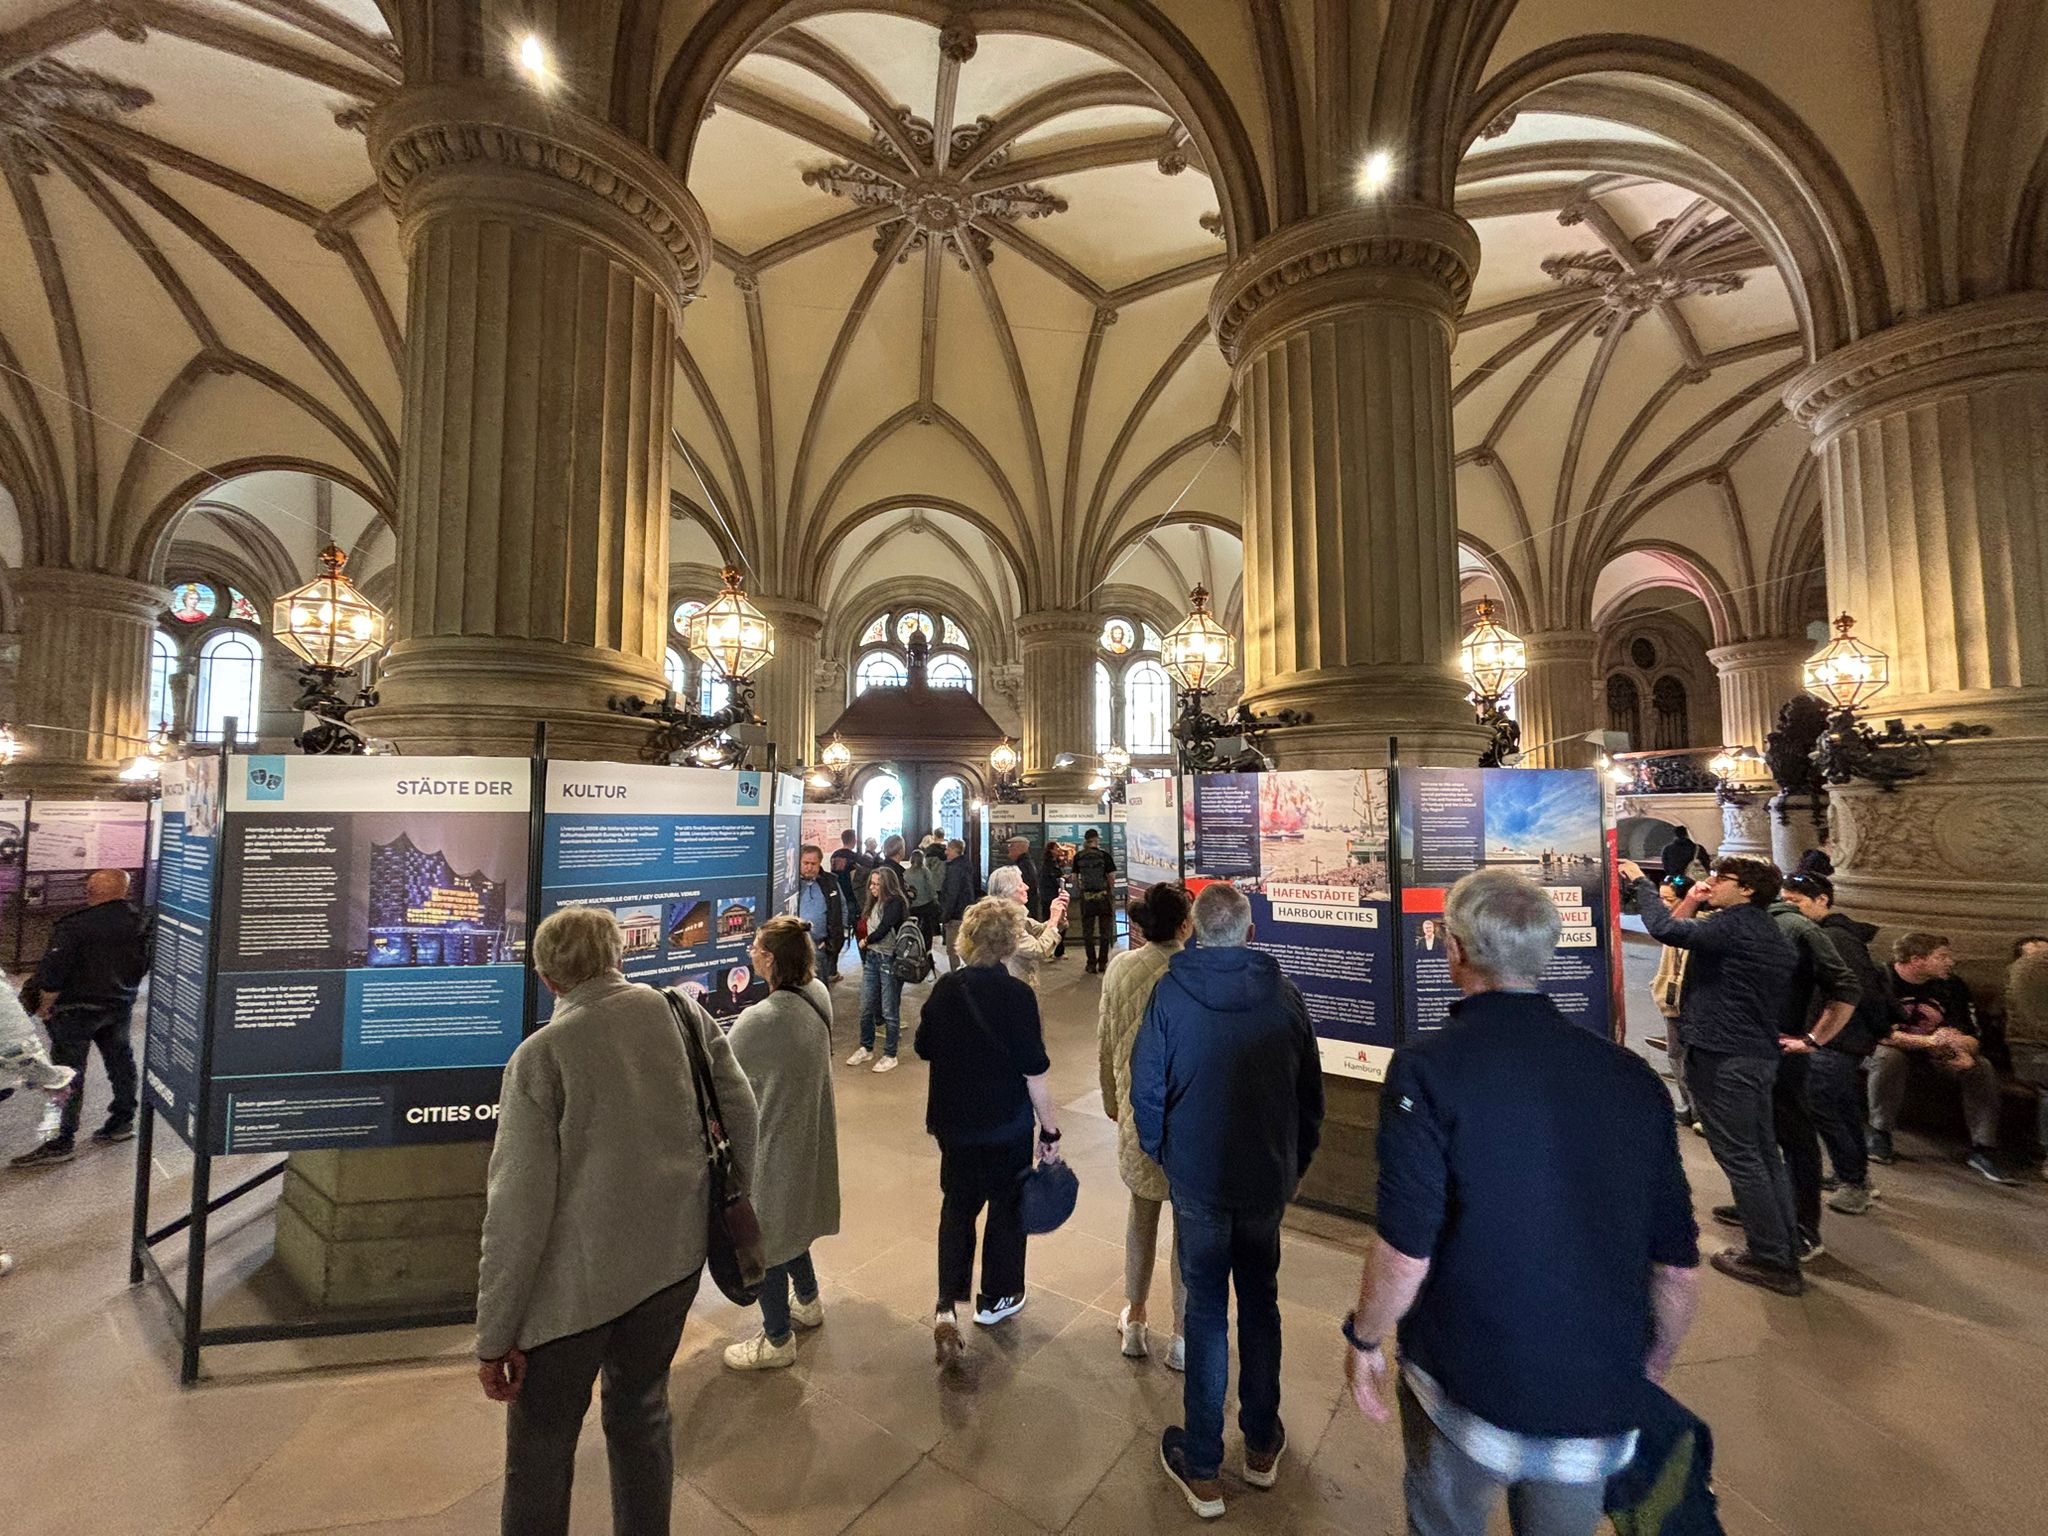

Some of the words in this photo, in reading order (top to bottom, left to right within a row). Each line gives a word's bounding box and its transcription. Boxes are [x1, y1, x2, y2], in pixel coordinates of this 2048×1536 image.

[397, 777, 470, 795] STÄDTE
[475, 782, 513, 795] DER
[563, 784, 627, 799] KULTUR
[654, 892, 680, 900] CULTURAL
[1273, 888, 1355, 902] HAFENSTÄDTE
[1552, 890, 1579, 902] ÄTZE
[1279, 907, 1333, 920] HARBOUR
[1336, 911, 1373, 922] CITIES
[1561, 933, 1592, 943] TAGES
[1344, 1061, 1382, 1076] Hamburg
[406, 1105, 471, 1124] CITIES
[474, 1104, 500, 1120] OF
